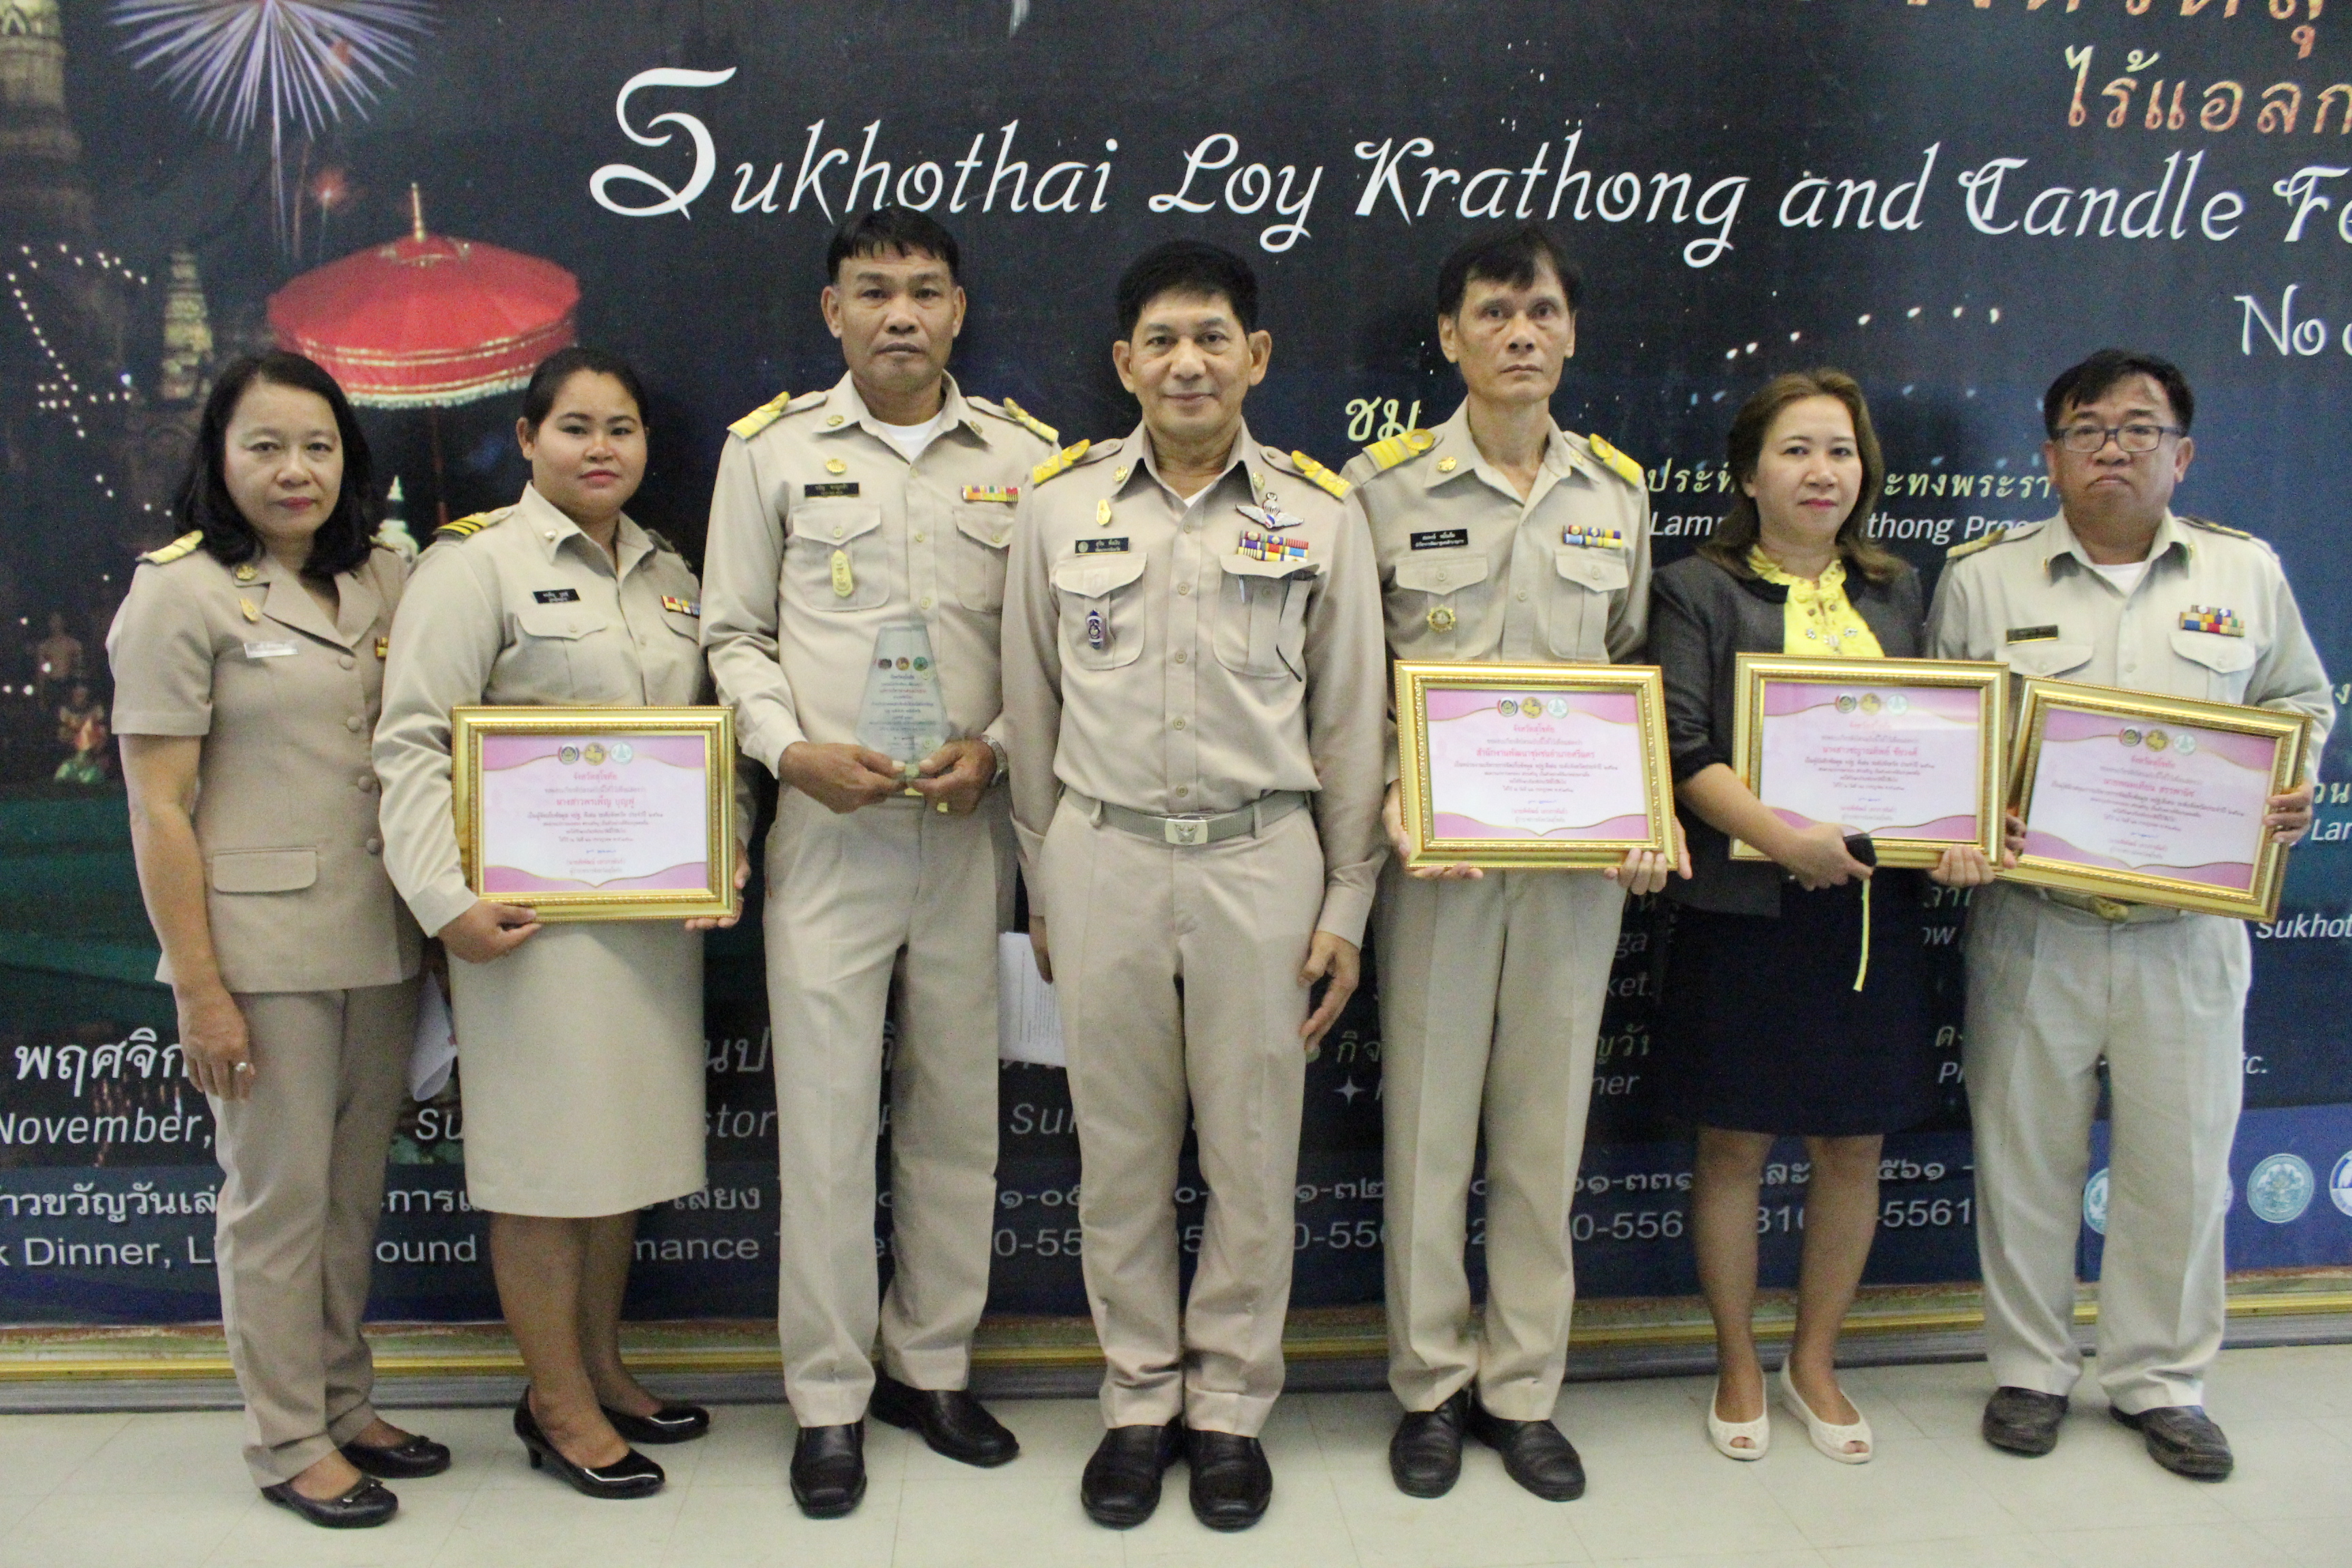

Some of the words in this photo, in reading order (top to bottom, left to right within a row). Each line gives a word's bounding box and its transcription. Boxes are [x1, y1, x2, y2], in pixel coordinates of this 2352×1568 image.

[589, 65, 1118, 225] Sukhothai
[1148, 132, 1324, 253] Loy
[1354, 129, 1751, 269] Krathong
[1778, 142, 1941, 231] and
[1957, 148, 2246, 242] Candle
[24, 1237, 171, 1269] Dinner,
[1572, 1210, 1684, 1241] 0-556
